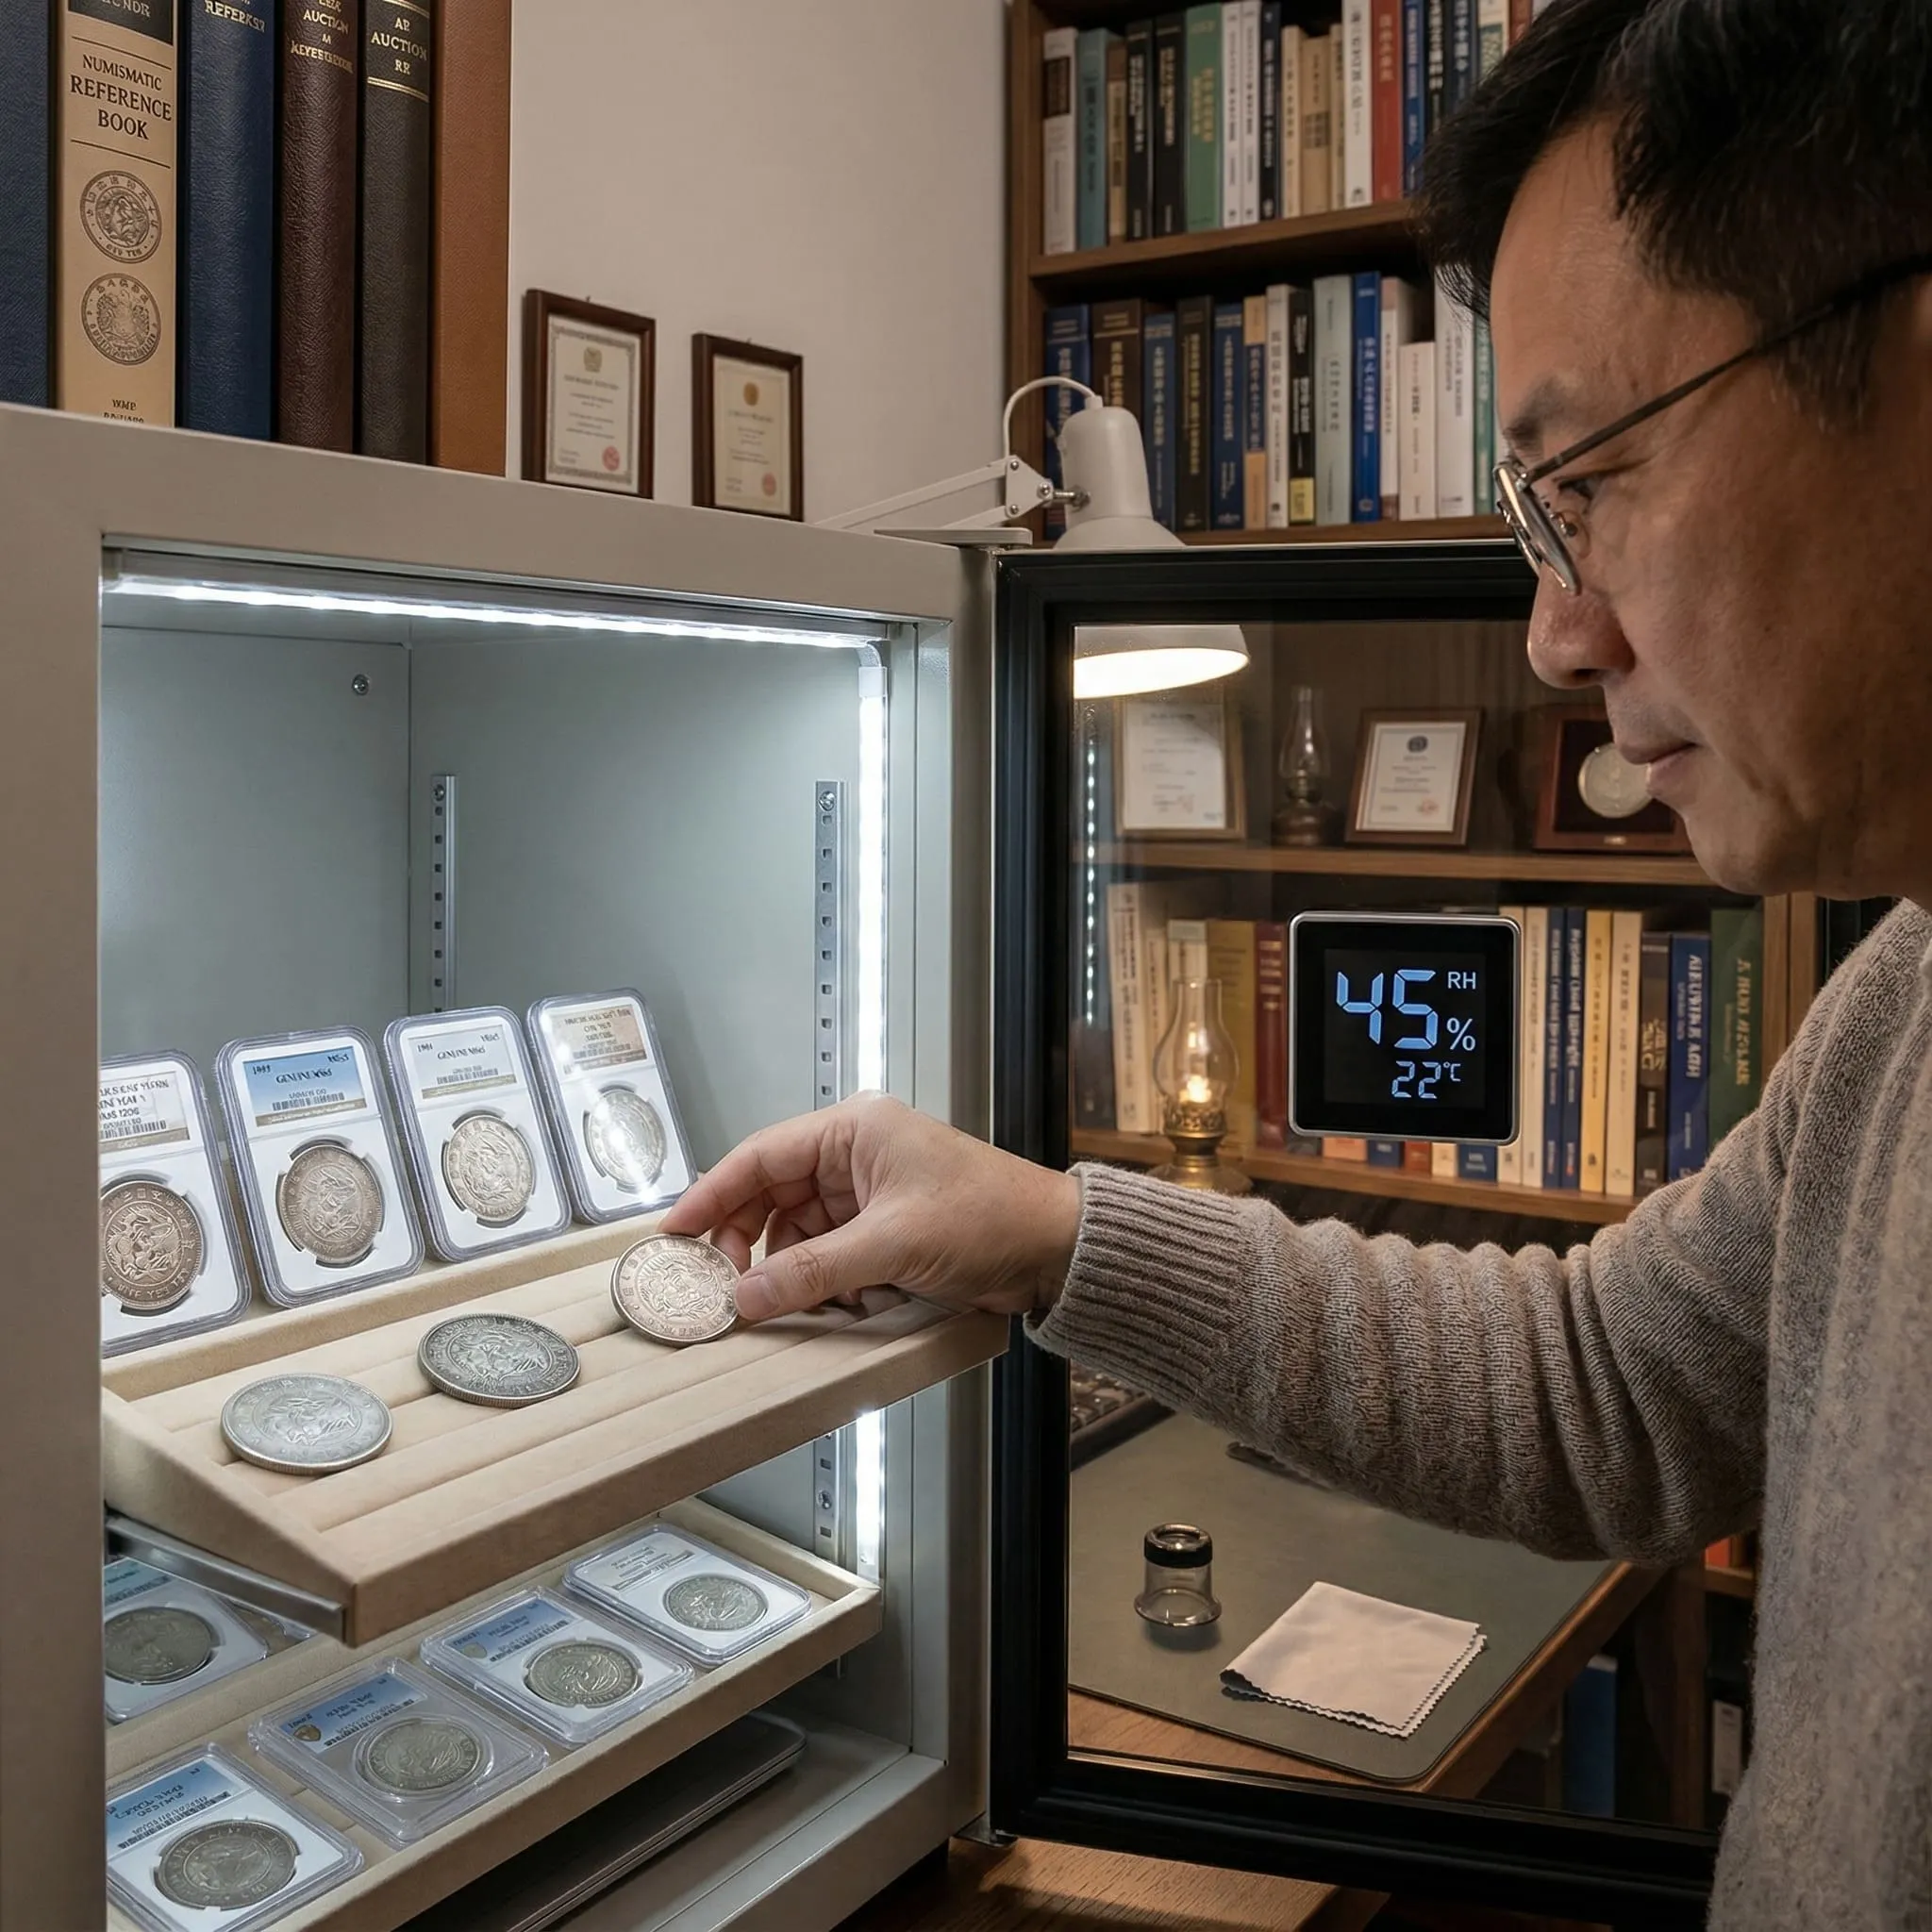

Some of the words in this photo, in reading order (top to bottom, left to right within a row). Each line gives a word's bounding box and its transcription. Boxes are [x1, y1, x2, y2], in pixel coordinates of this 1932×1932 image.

[370, 31, 427, 60] AUCTION
[82, 54, 162, 92] NUMISMATIC
[70, 75, 172, 121] REFERENCE
[97, 108, 149, 140] BOOK
[1447, 972, 1476, 990] RH
[1337, 970, 1439, 1050] 45
[1446, 1017, 1476, 1051] %
